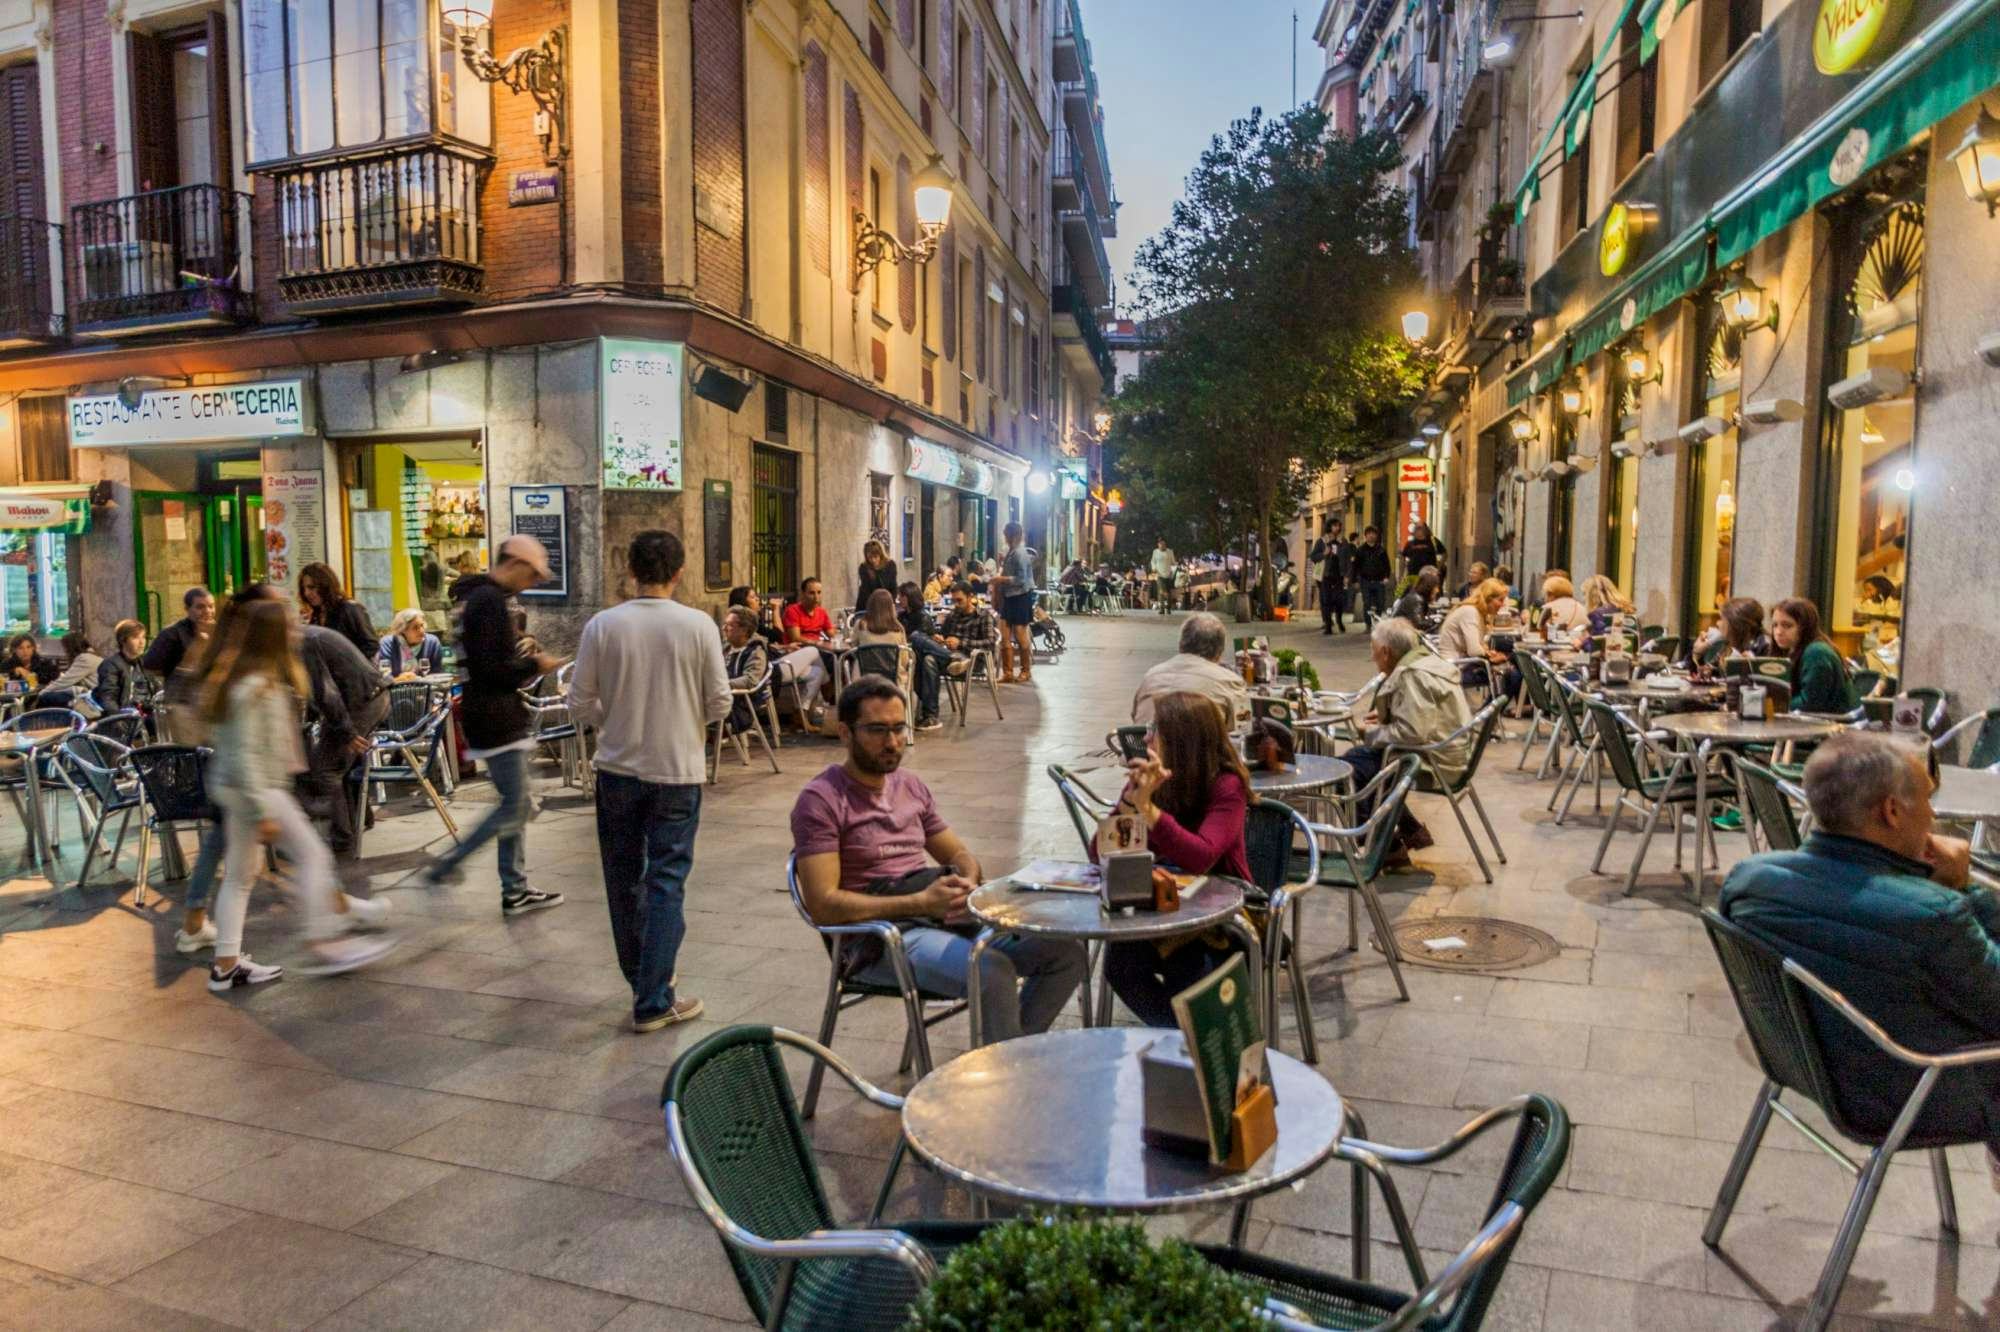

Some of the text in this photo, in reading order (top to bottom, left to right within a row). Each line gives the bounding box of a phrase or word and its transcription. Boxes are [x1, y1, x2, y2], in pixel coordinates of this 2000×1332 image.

[1823, 0, 1886, 44] VALO
[190, 386, 299, 419] CERVECERIA
[7, 506, 50, 516] Mahou
